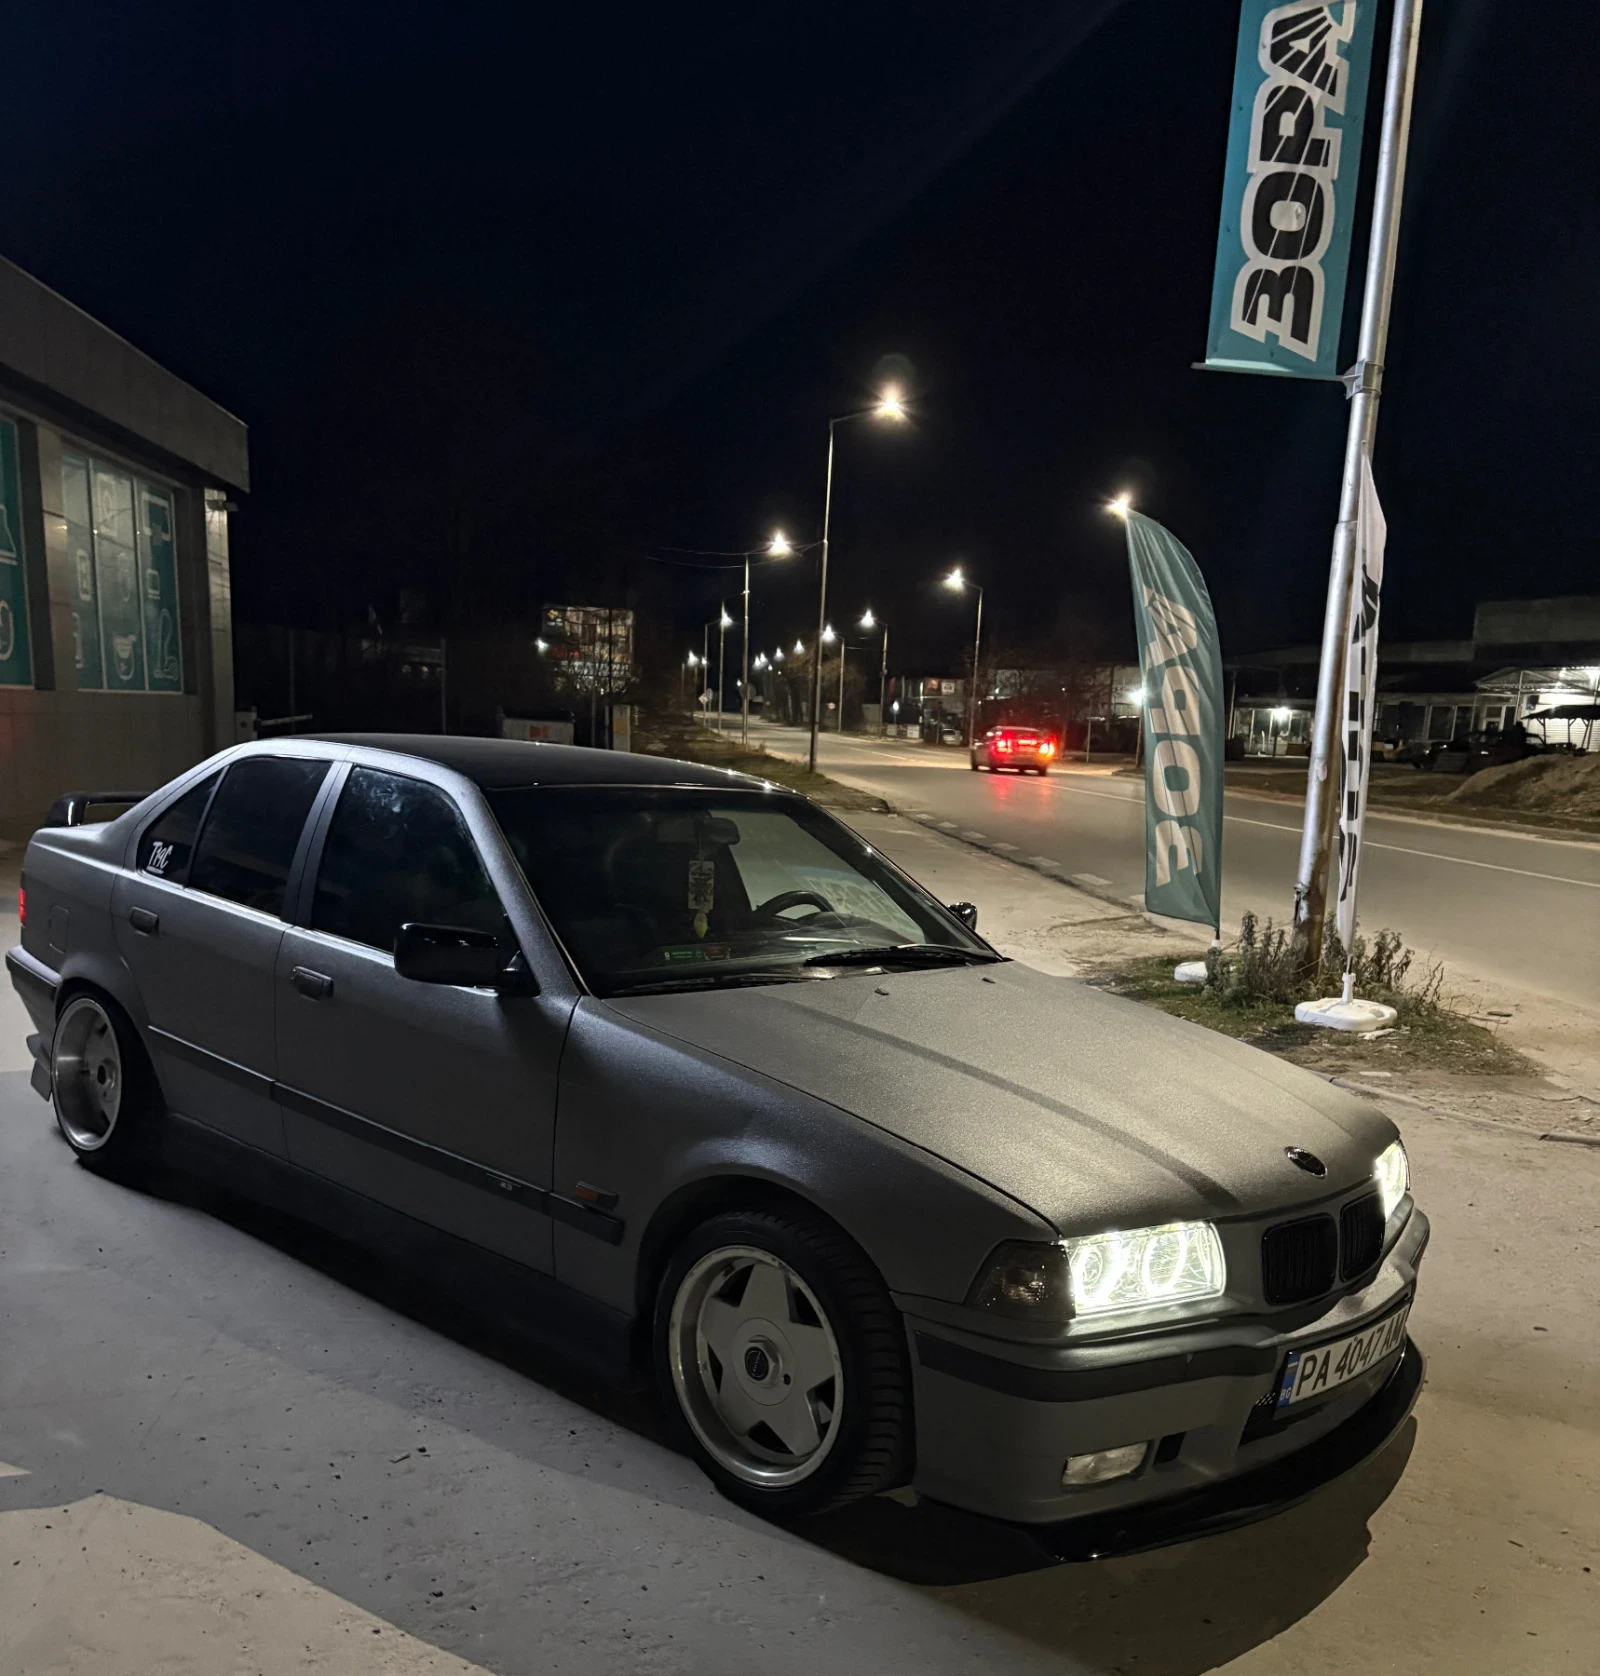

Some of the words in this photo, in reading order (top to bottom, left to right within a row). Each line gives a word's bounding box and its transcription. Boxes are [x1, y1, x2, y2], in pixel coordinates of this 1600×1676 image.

[1232, 0, 1352, 360] ЗОРА
[1280, 1387, 1292, 1401] BG
[1296, 1350, 1331, 1397] PA
[1334, 1324, 1386, 1380] 4047
